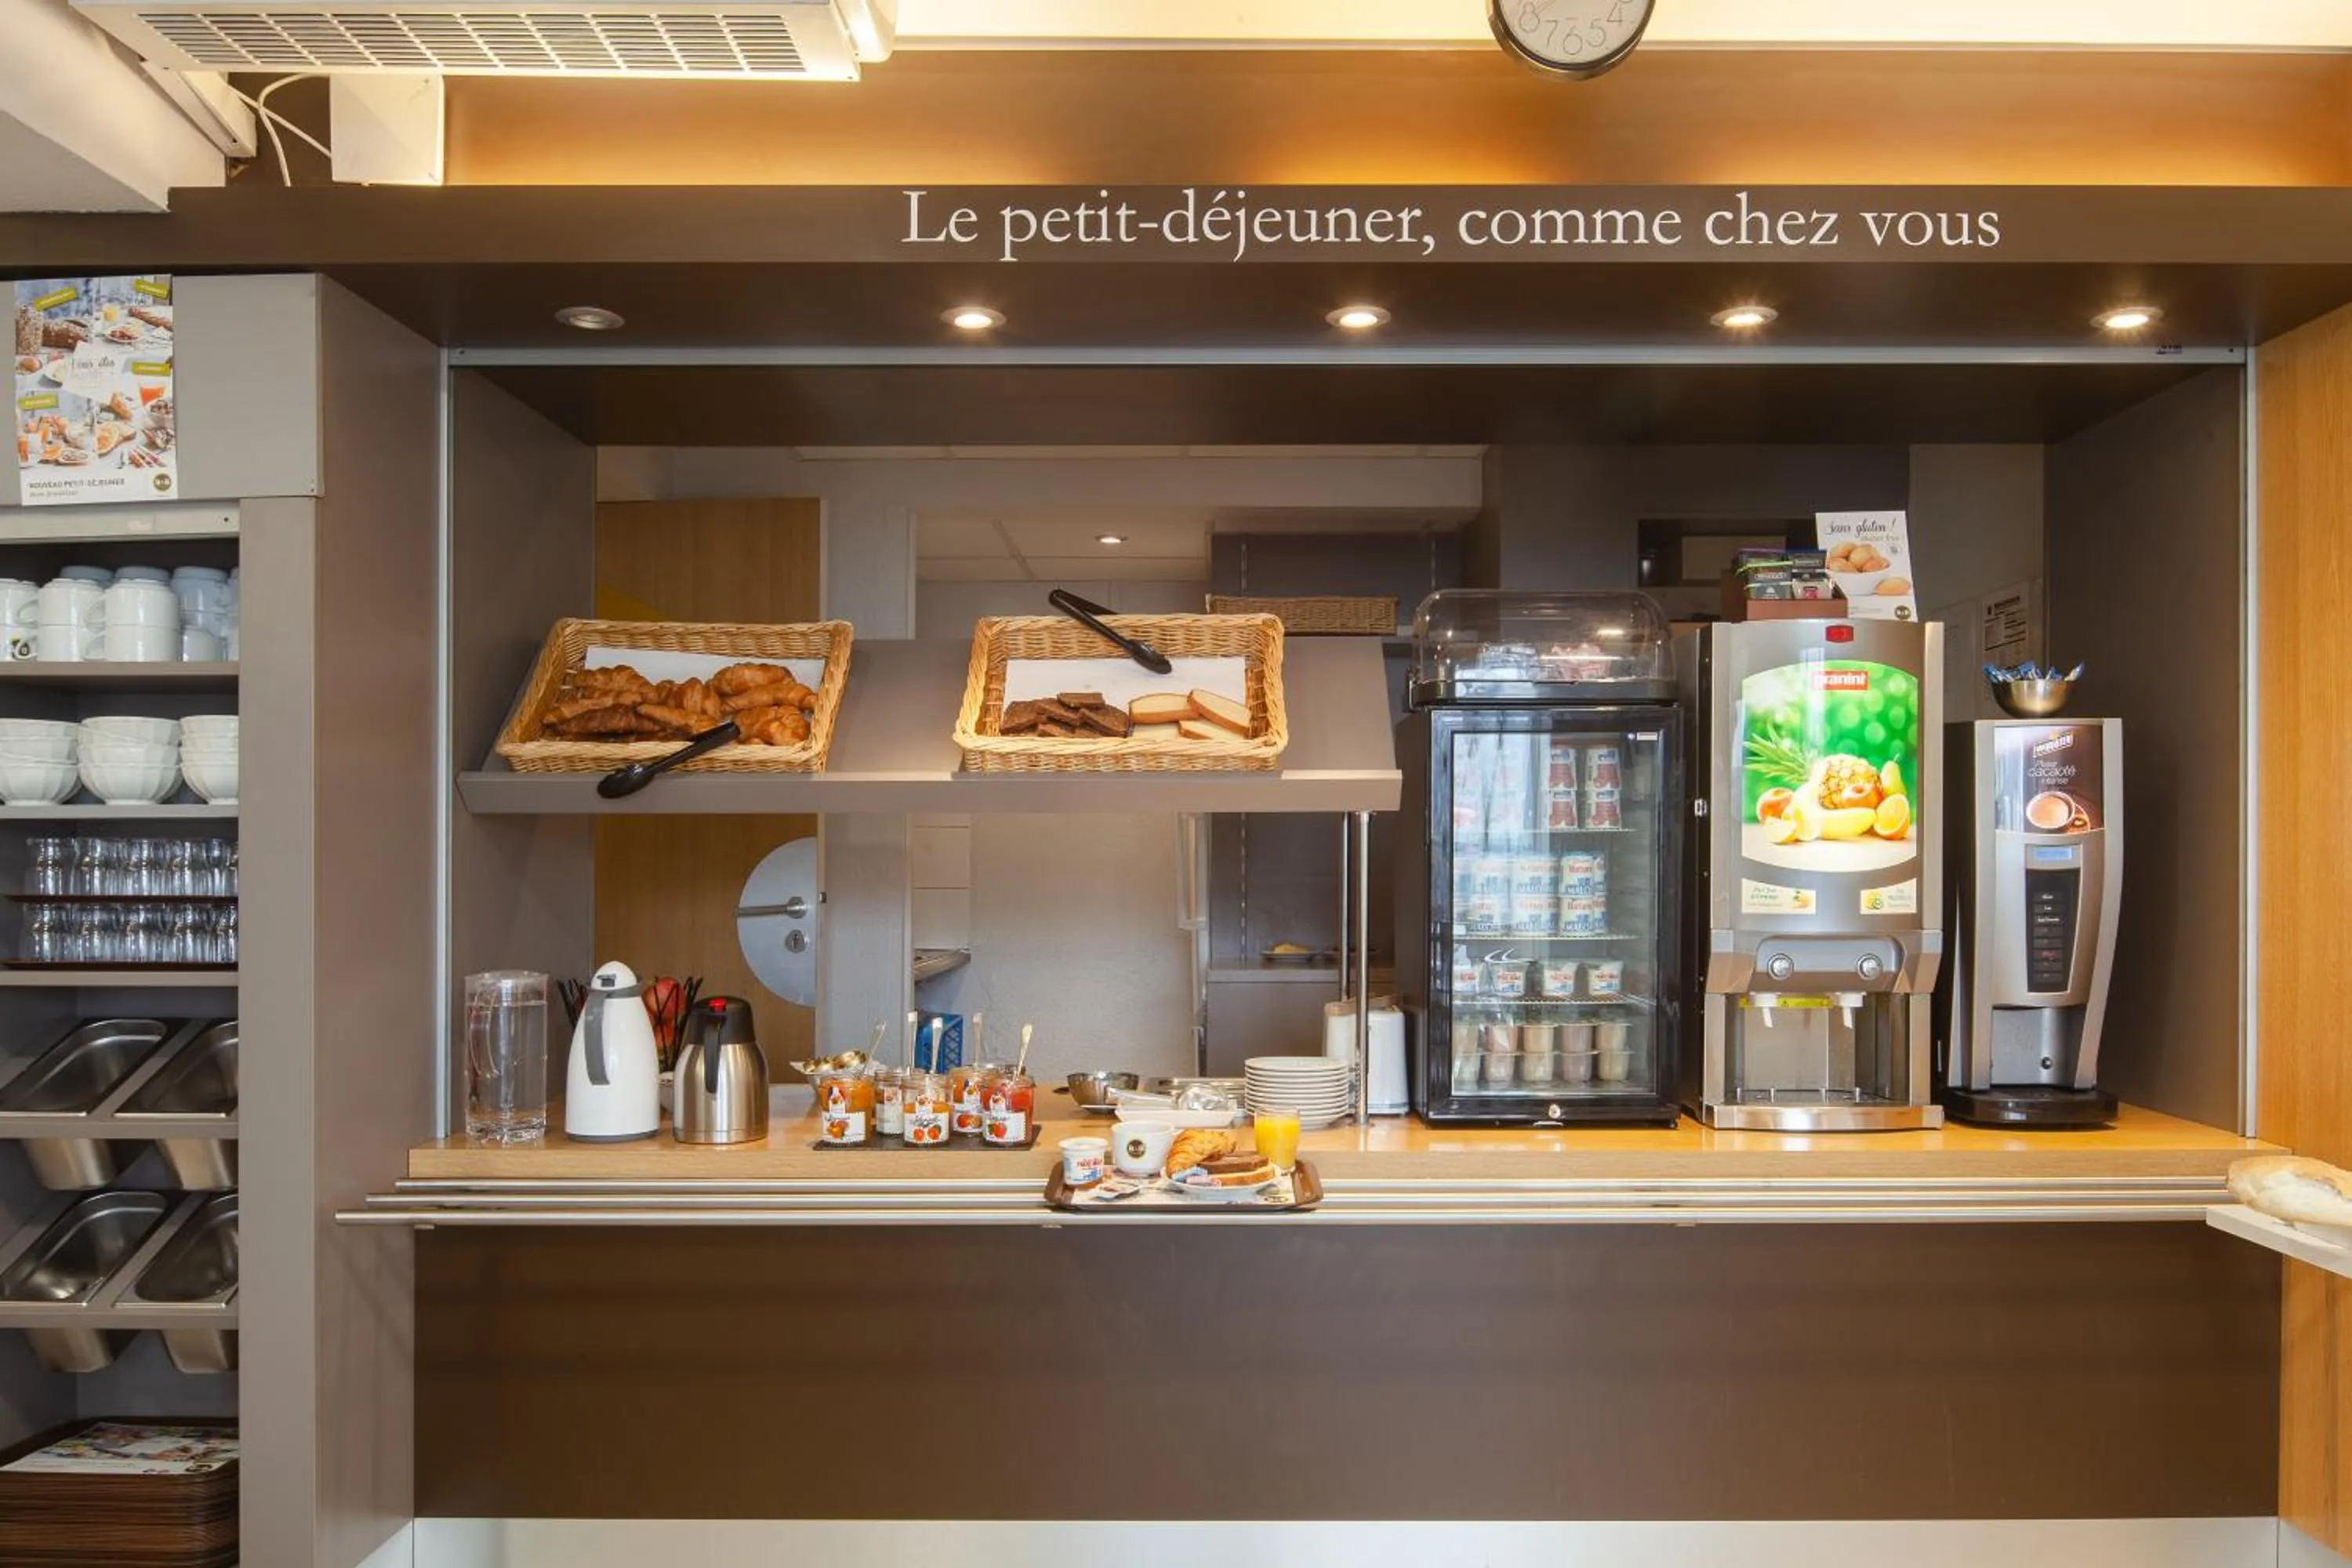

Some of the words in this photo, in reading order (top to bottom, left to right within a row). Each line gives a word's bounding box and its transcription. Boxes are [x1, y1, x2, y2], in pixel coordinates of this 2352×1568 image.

[1519, 1, 1541, 34] 8
[1606, 0, 1624, 27] 4
[1544, 20, 1559, 46] 7
[1563, 24, 1583, 56] 6
[1586, 18, 1606, 47] 5
[901, 191, 978, 243] Le
[998, 187, 1436, 263] petit-déjeuner,
[1457, 208, 1682, 246] comme
[1704, 190, 1839, 246] chez
[1858, 210, 2001, 248] vous
